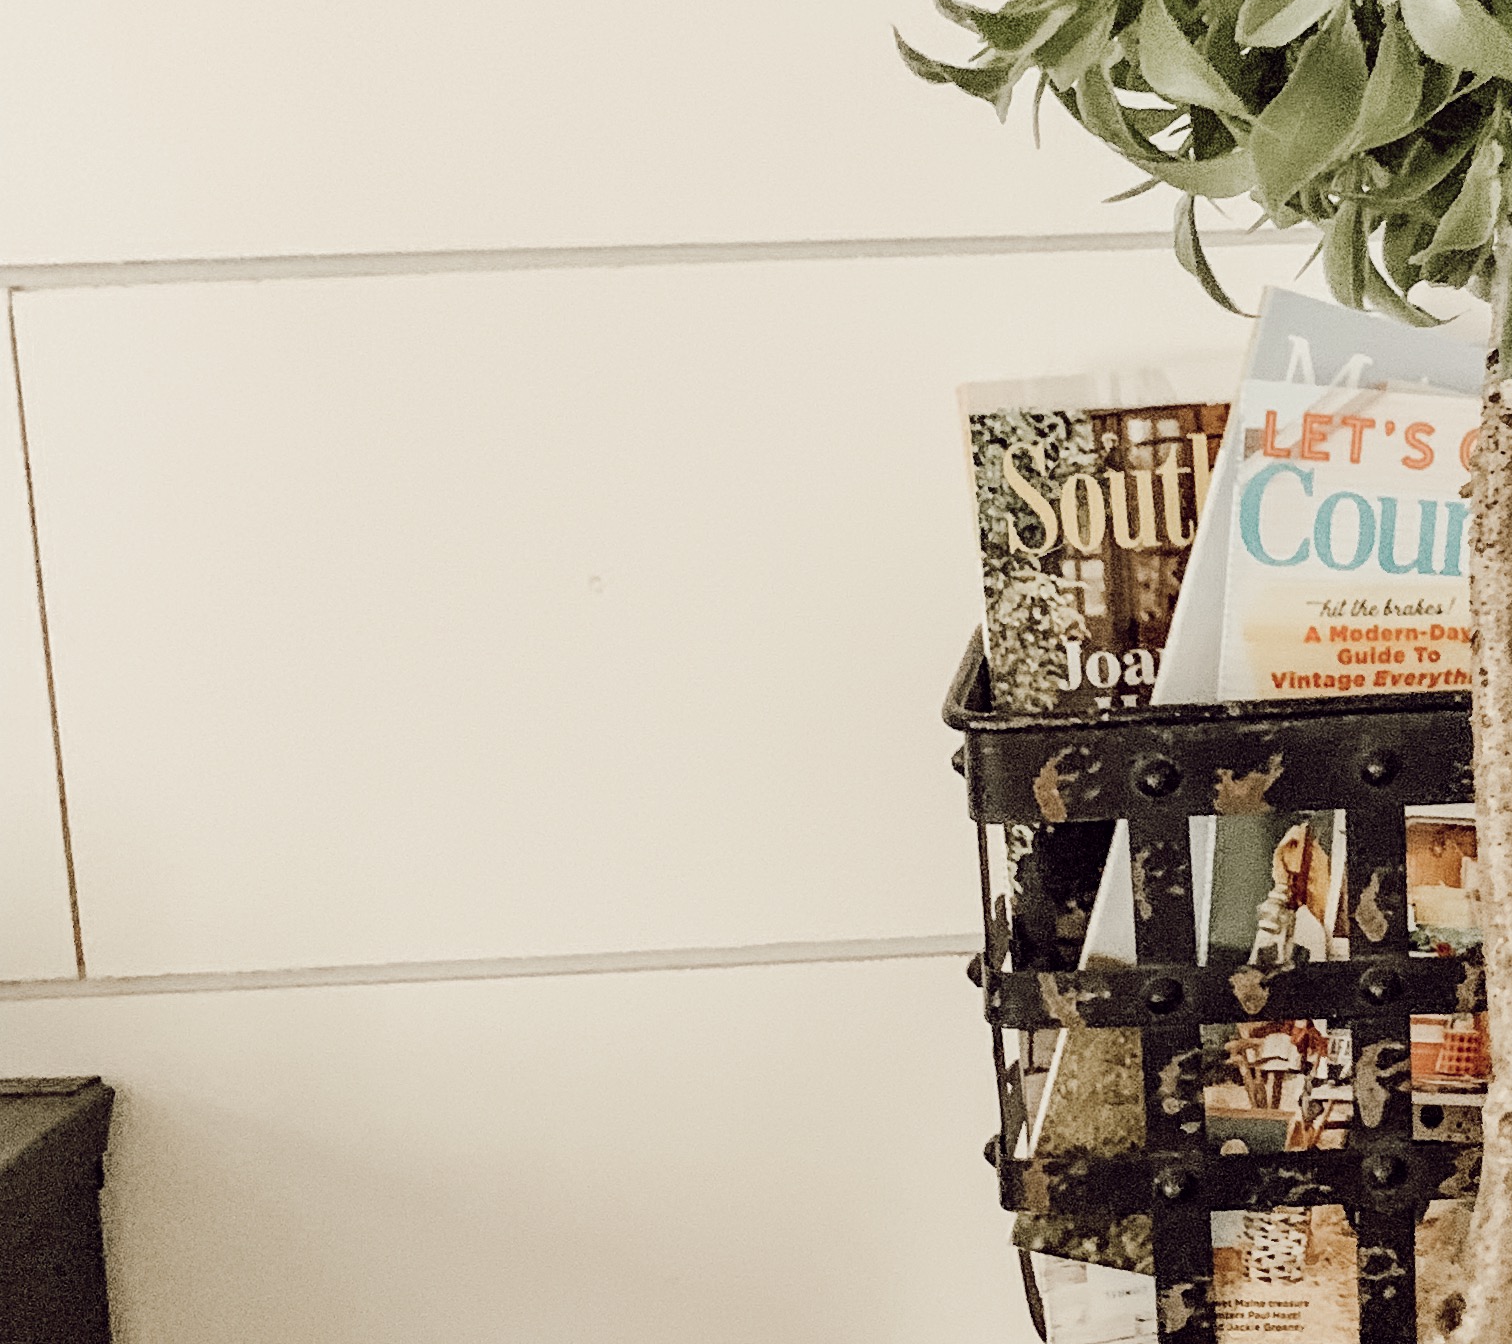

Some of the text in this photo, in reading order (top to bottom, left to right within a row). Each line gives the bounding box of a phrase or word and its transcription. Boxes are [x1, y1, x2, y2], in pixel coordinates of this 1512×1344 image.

[1262, 409, 1436, 471] LET'S
[1351, 599, 1379, 617] the
[1383, 598, 1456, 617] brakes!
[1304, 624, 1472, 643] A Modern-Day
[1059, 635, 1166, 691] Joa
[1337, 646, 1441, 665] Guide To
[1271, 670, 1366, 691] Vintage
